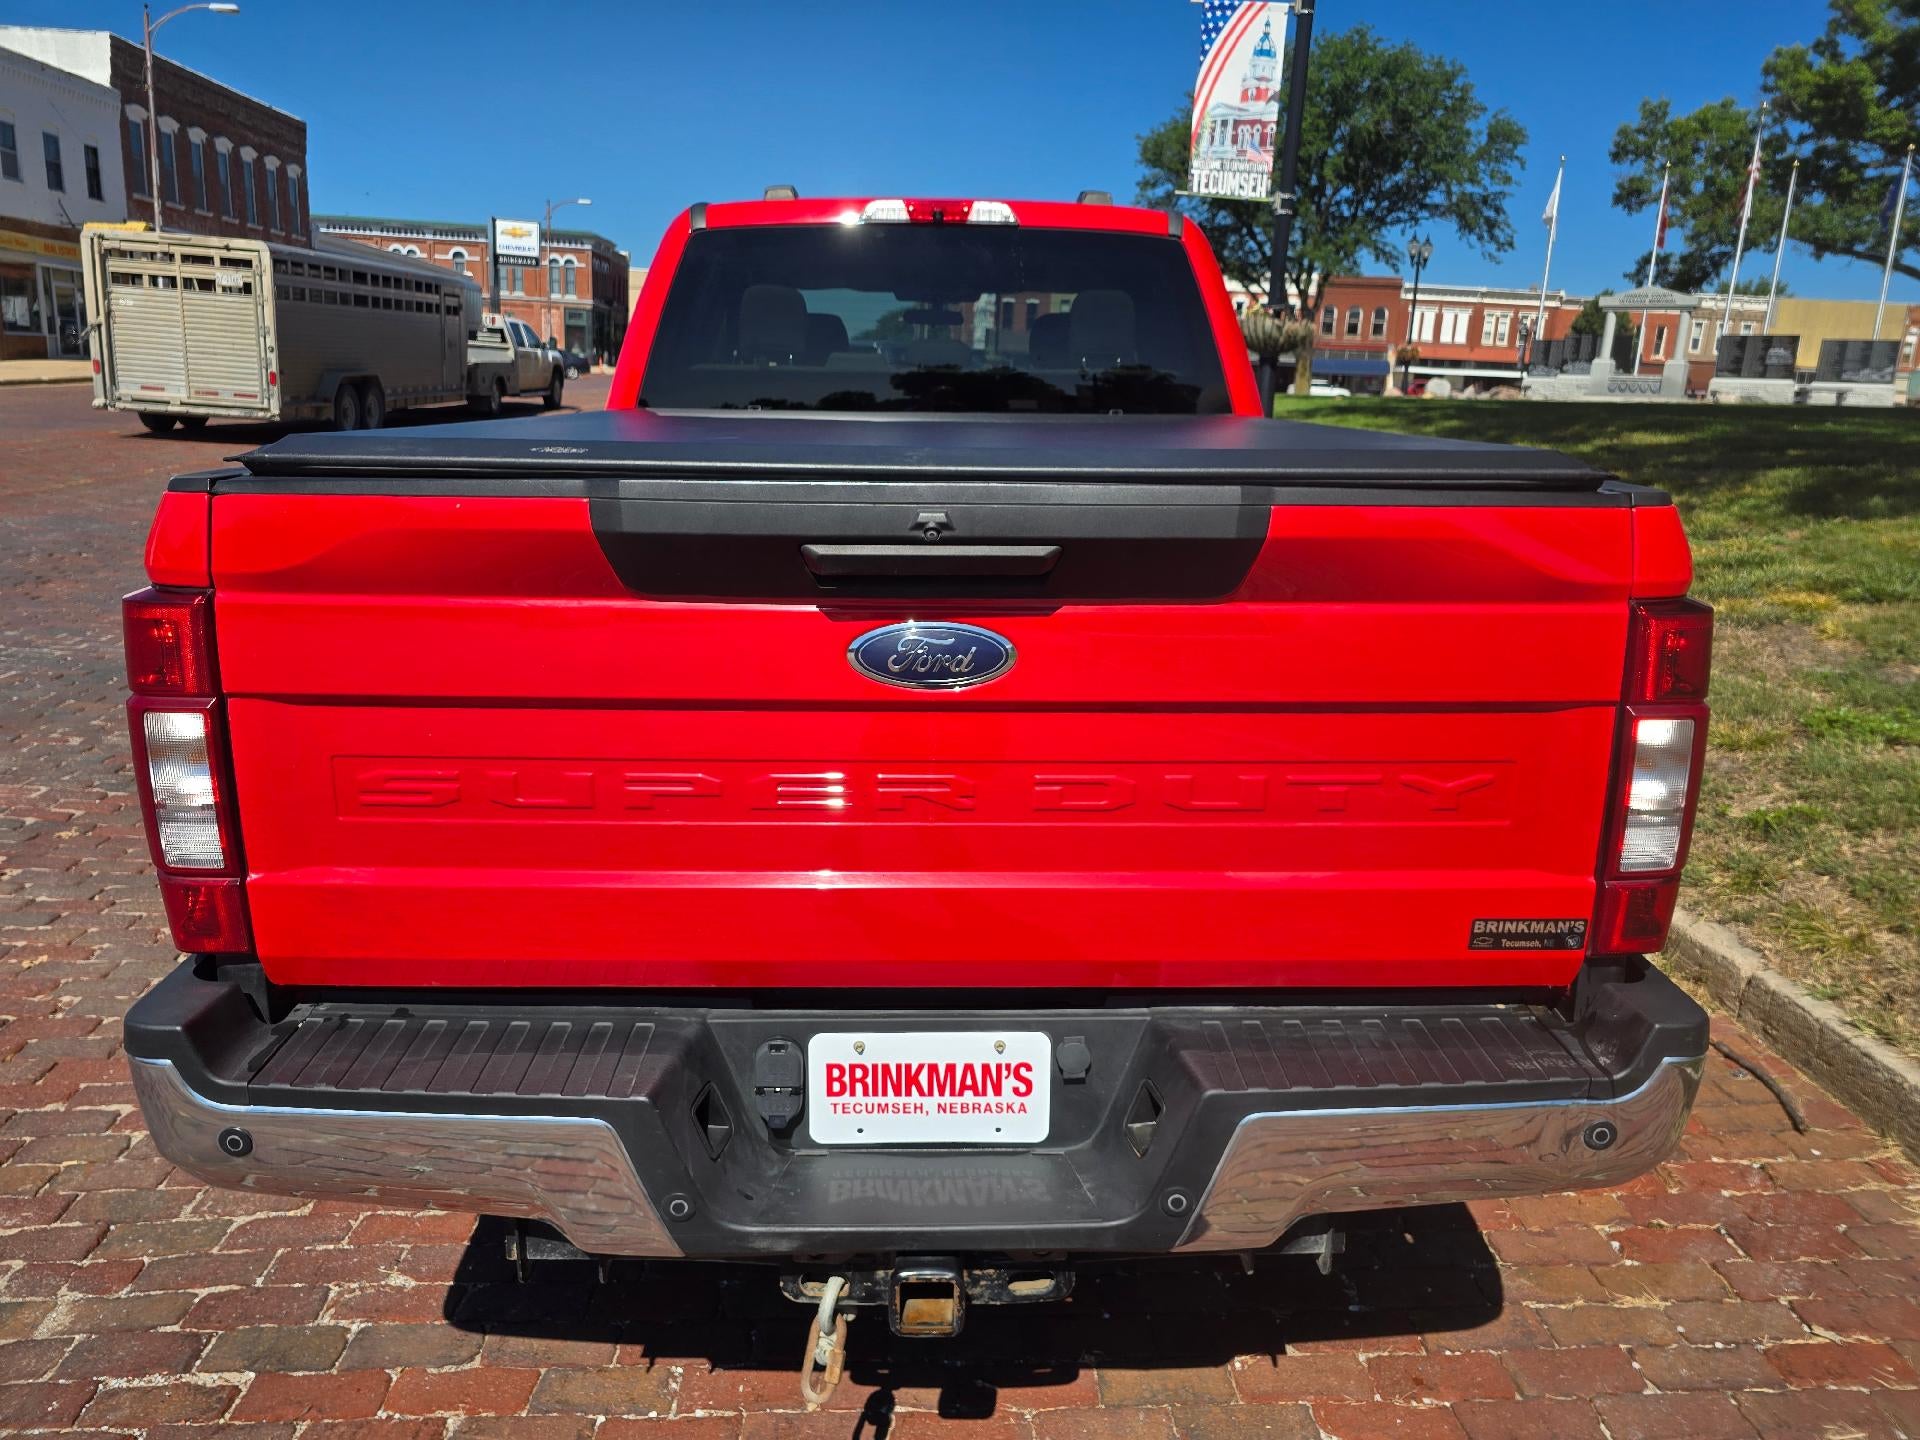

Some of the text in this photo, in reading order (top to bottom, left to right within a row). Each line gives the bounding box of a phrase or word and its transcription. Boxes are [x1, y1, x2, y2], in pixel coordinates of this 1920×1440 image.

[1191, 169, 1268, 198] TECUMSEH
[887, 636, 976, 673] Ford
[357, 771, 1495, 812] SUPER DUTY
[1473, 920, 1585, 933] BRINKMAN'S
[1501, 938, 1542, 948] Tecumseh,
[825, 1061, 1033, 1098] BRINKMAN'S
[830, 1102, 1028, 1116] TECUMSEH, NEBRASKA
